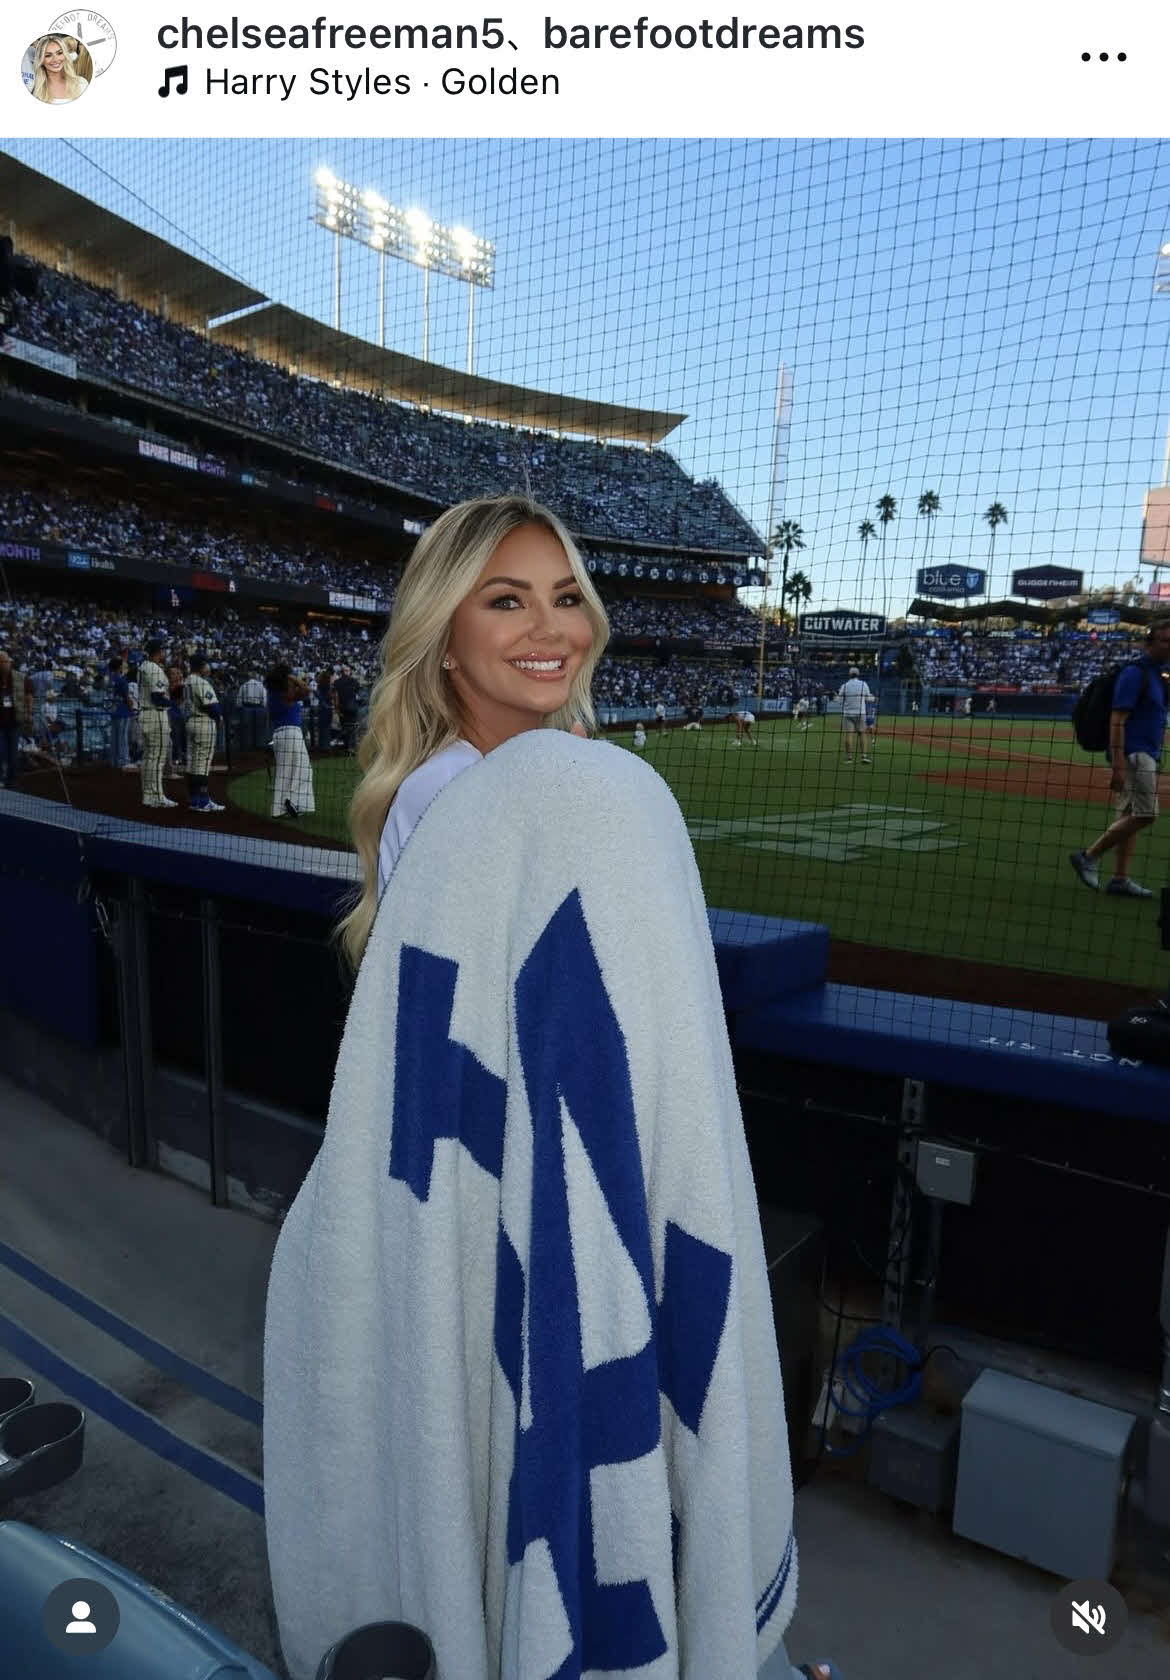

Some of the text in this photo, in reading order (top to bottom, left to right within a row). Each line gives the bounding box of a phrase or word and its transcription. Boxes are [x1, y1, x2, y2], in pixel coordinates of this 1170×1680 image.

[923, 570, 961, 586] blue
[1017, 579, 1079, 587] GUGGENHEIM
[804, 616, 879, 632] CUTWATER
